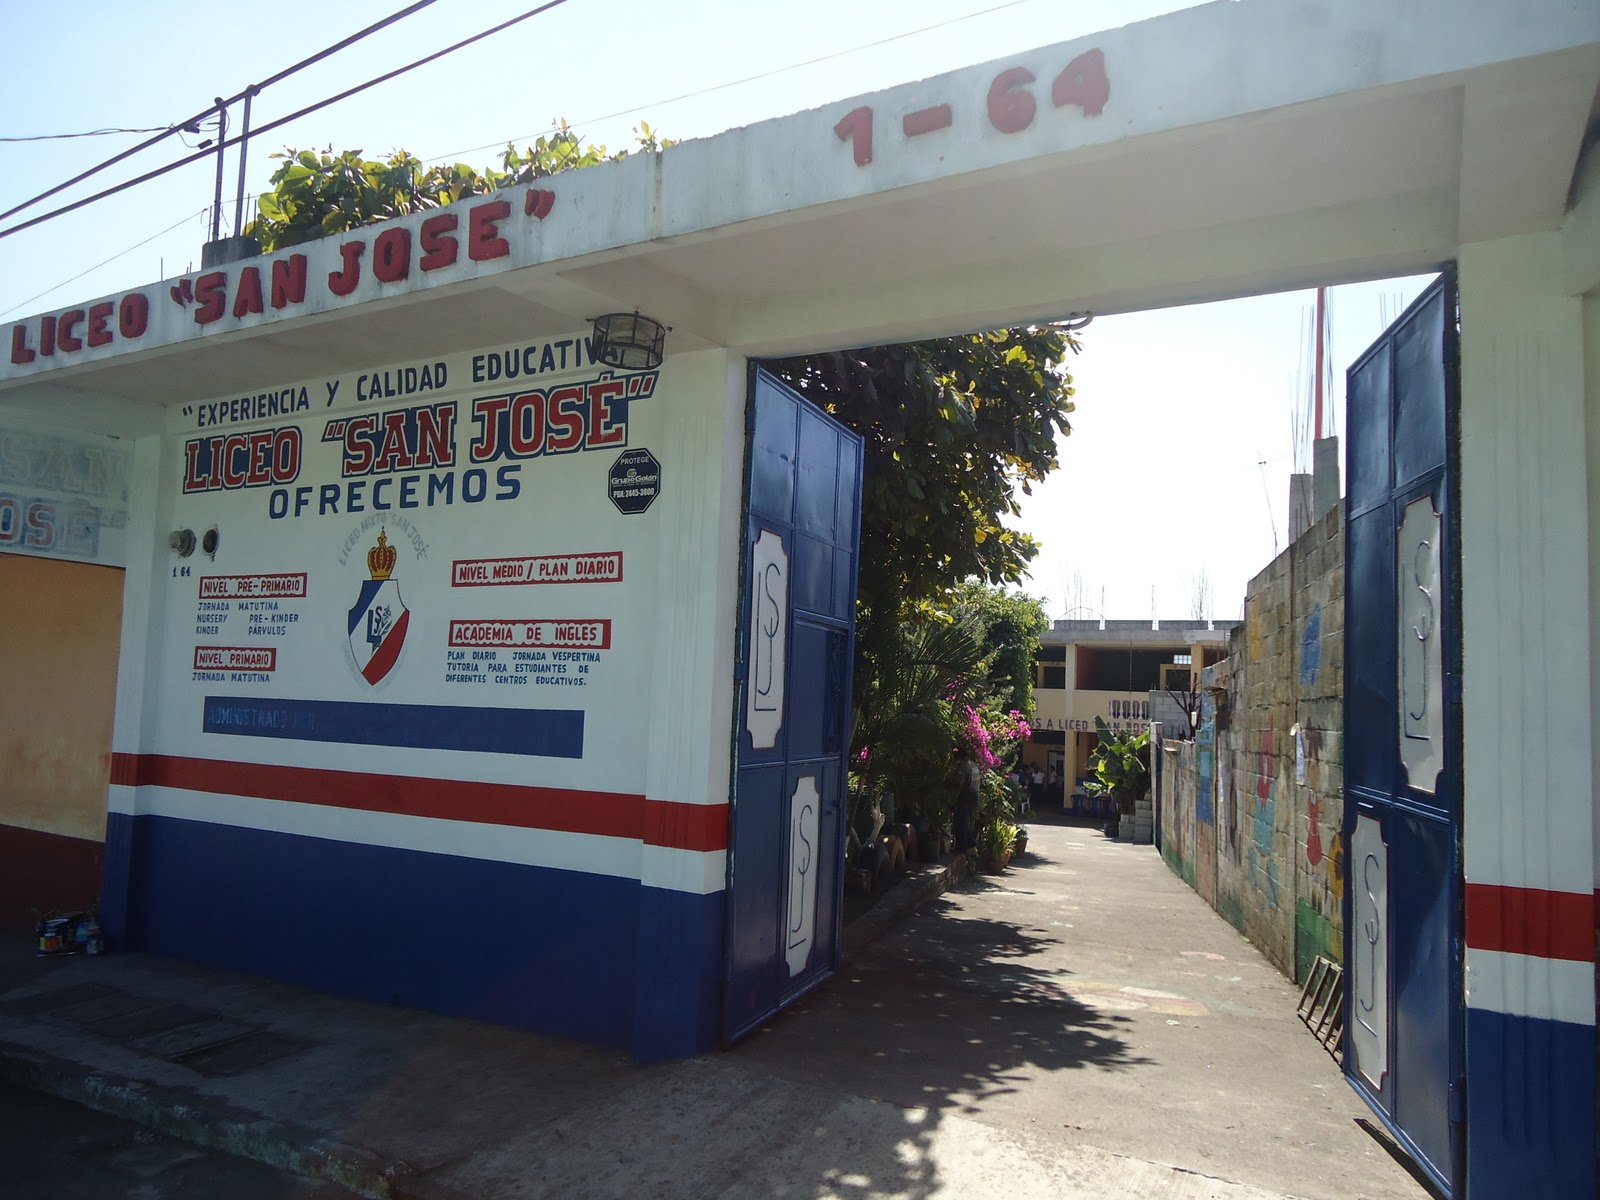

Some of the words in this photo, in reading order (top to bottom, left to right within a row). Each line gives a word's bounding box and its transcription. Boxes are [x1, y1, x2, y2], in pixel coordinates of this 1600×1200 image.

[10, 292, 149, 365] LICEO
[170, 255, 308, 325] "SAN
[328, 187, 556, 297] JOSE"
[326, 380, 340, 408] Y
[356, 361, 448, 402] CALIDAD
[183, 426, 302, 494] LICEO
[322, 402, 457, 476] "SAN
[620, 456, 650, 465] PROTEGE
[268, 464, 523, 520] OFRECEMOS
[339, 528, 361, 567] LICEO
[360, 512, 387, 533] MIXTO
[459, 566, 488, 581] NIVEL
[492, 564, 524, 580] MEDIO
[539, 562, 569, 577] PLAN
[575, 559, 615, 575] DIARIO
[203, 581, 229, 593] NIVEL
[237, 579, 300, 593] PRE-PRIMARIO
[198, 602, 230, 611] JORNADA
[238, 602, 279, 611] MATUTINA
[196, 614, 229, 623] NURSERY
[195, 626, 219, 635] KINDER
[454, 626, 514, 641] ACADEMIA
[526, 626, 542, 641] DE
[555, 626, 598, 641] INGLES
[198, 652, 223, 664] NIVEL
[229, 653, 269, 666] PRIMARIO
[447, 651, 466, 661] PLAN
[472, 651, 497, 661] DIARIO
[512, 651, 547, 661] JORNADA
[552, 651, 601, 663] VESPERTINA
[447, 662, 479, 672] TUTORIA
[487, 662, 508, 673] PARA
[514, 663, 567, 674] ESTUDIANTES
[578, 664, 590, 674] DE
[192, 672, 226, 682] JORNADA
[230, 673, 271, 683] MATUTINA
[445, 674, 487, 684] DIFERENTES
[495, 675, 528, 685] CENTROS
[535, 676, 588, 686] EDUCATIVOS.
[1058, 719, 1089, 730] LICEO
